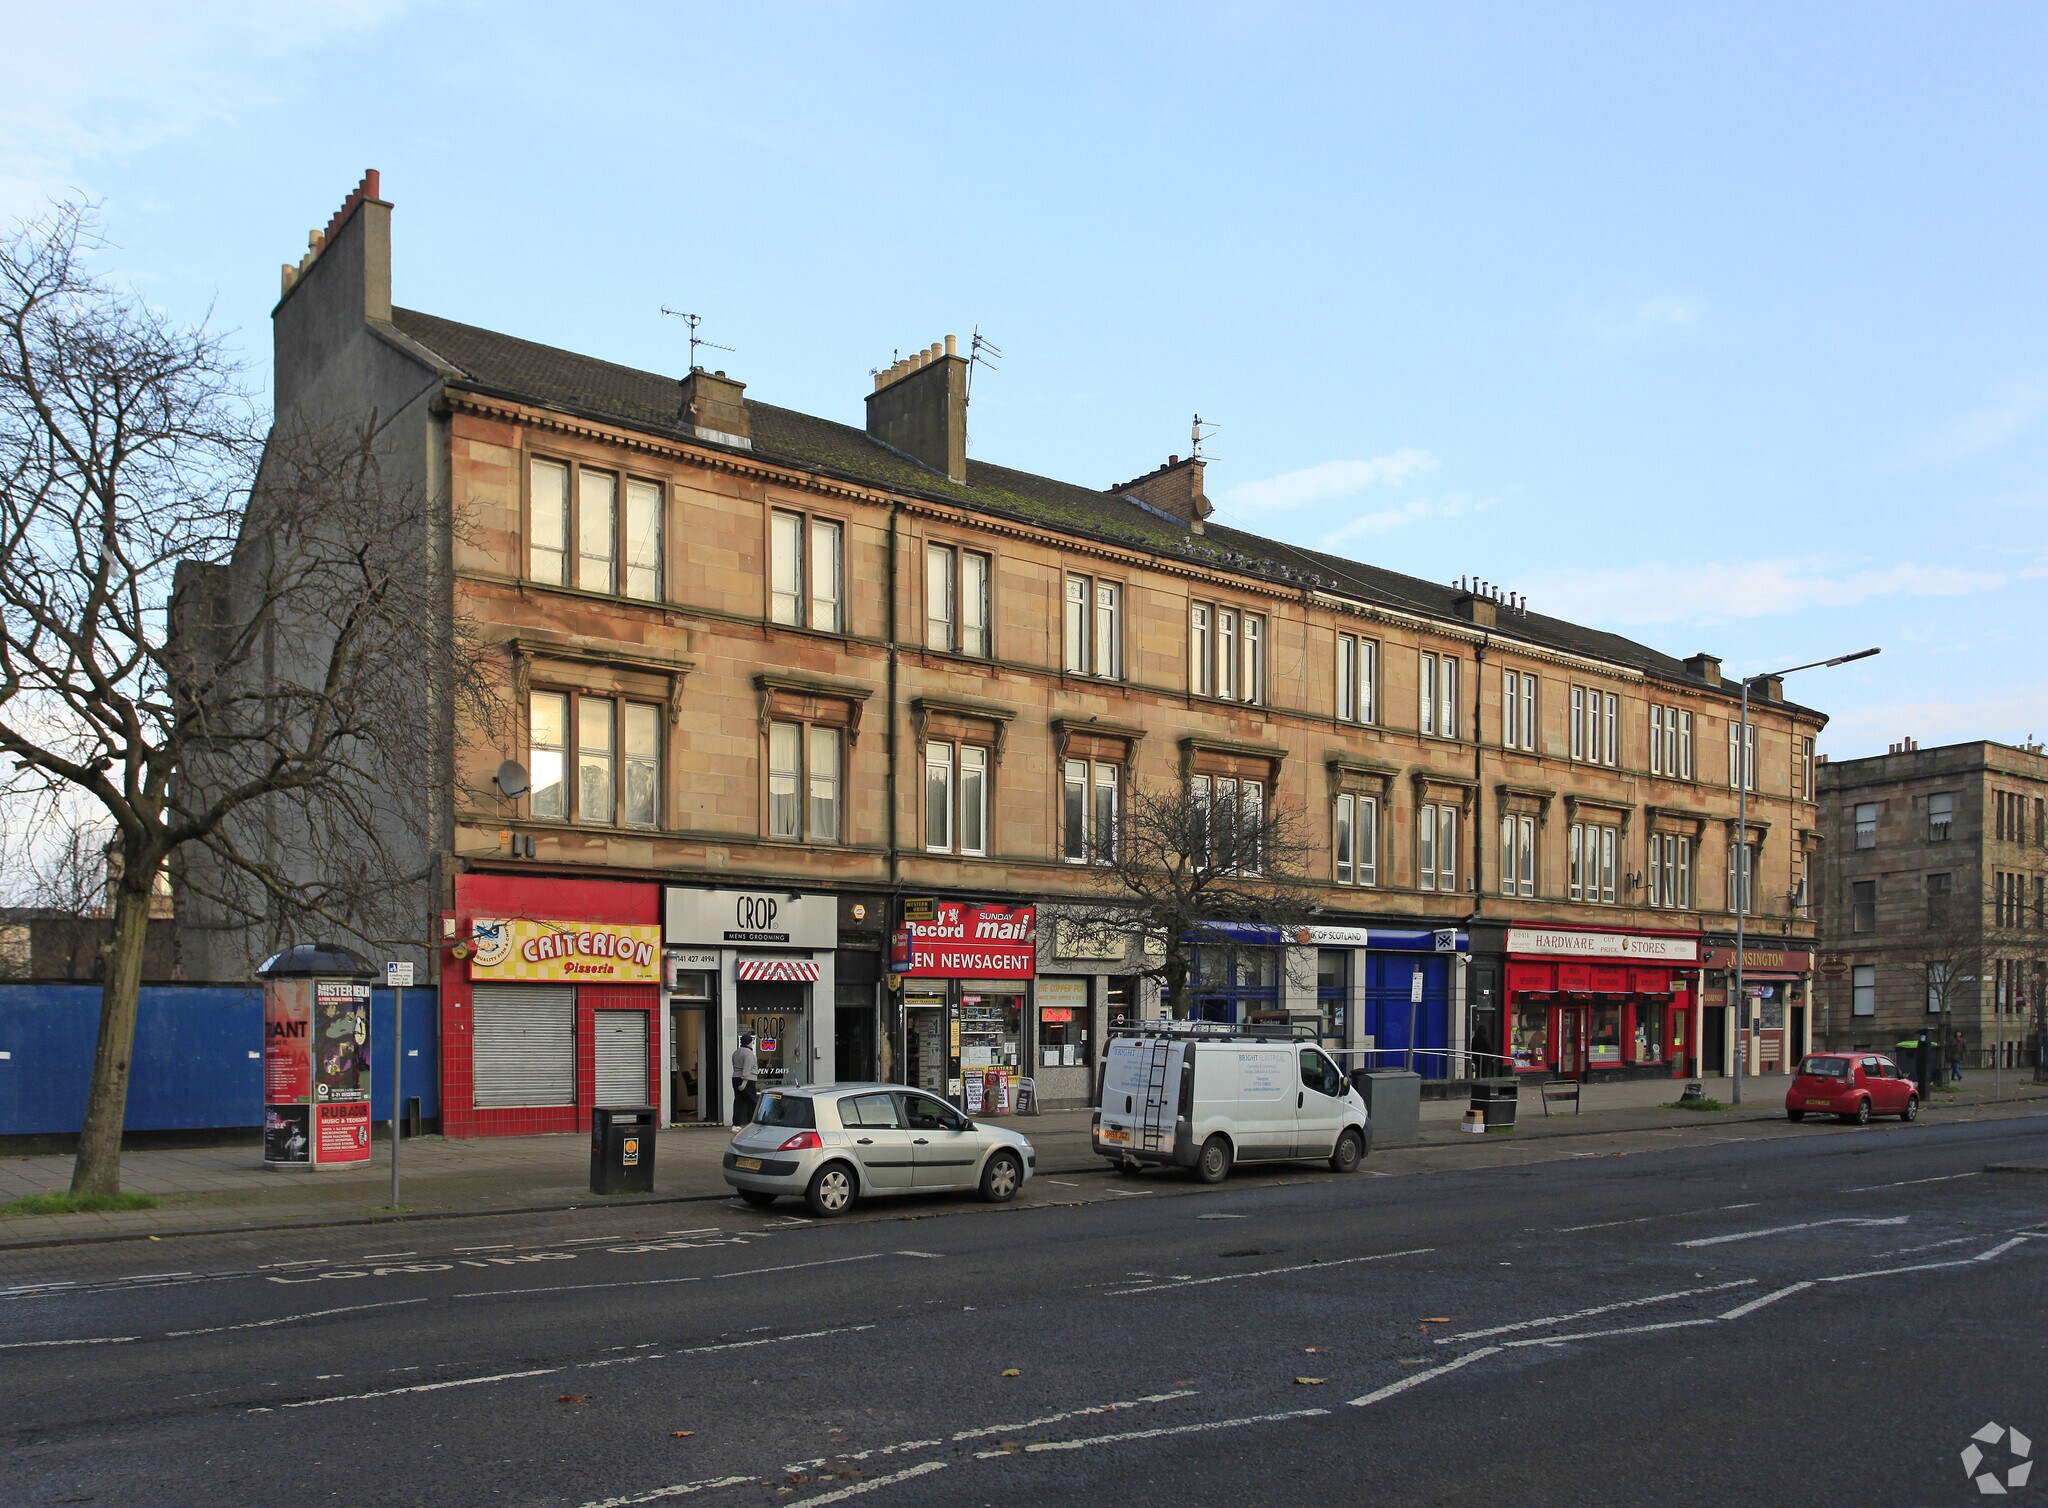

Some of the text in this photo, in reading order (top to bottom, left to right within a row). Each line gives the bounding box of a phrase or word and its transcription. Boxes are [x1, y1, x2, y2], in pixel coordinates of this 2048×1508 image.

[737, 896, 777, 929] CROP
[979, 912, 1014, 920] SUNDAY
[905, 914, 1030, 940] Record mail
[1318, 931, 1327, 940] OF
[1328, 931, 1361, 941] SCOTLAND
[1535, 935, 1595, 950] HARDWARE
[497, 948, 506, 957] FISH
[523, 932, 654, 967] CRITERION
[1631, 941, 1666, 954] STORES
[687, 955, 699, 963] 427
[941, 953, 1030, 970] NEWSAGENT
[1731, 952, 1784, 967] KNSINGTON
[564, 961, 614, 975] Pizzeria
[317, 984, 353, 996] MISTER
[1705, 994, 1724, 1002] LOUNGE
[757, 1017, 785, 1039] CROP
[1113, 1048, 1136, 1057] BRIGHT
[266, 1237, 750, 1284] LOADING ONLY
